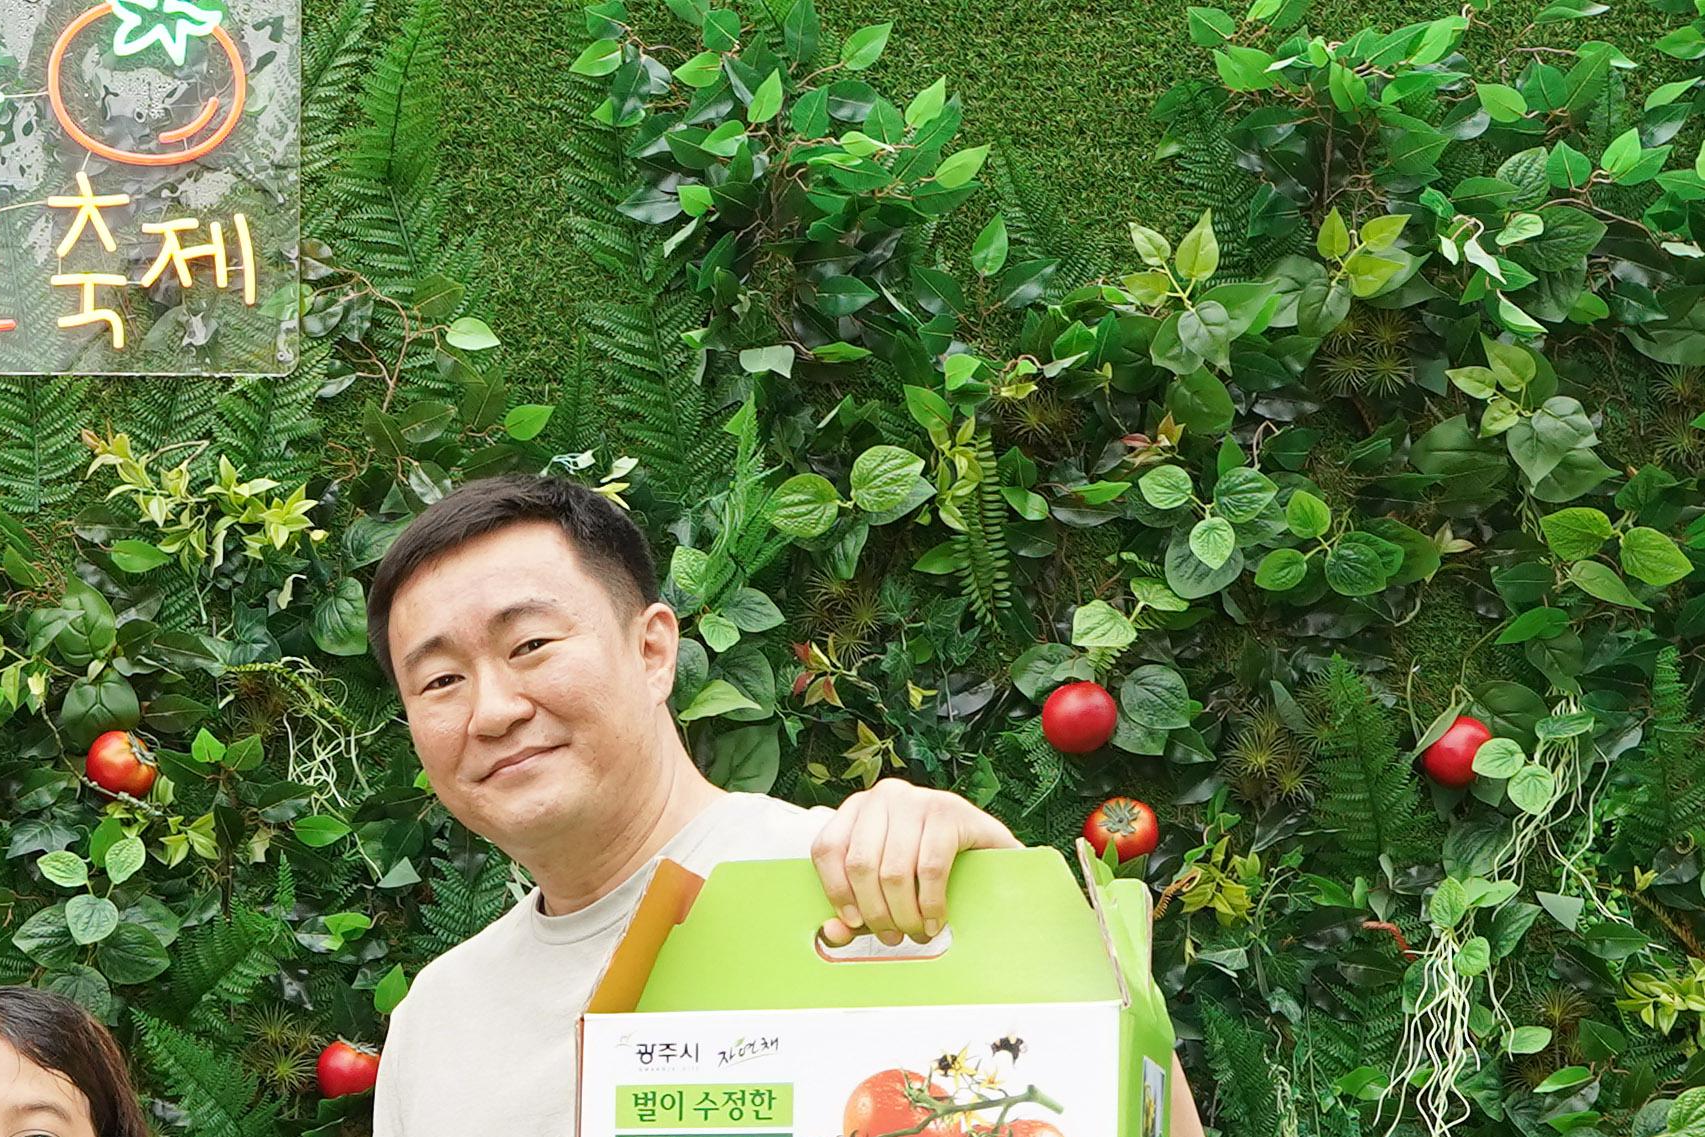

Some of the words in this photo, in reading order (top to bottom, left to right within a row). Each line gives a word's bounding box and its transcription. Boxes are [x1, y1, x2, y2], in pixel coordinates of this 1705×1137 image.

[47, 171, 257, 349] 축제
[636, 1042, 699, 1065] 광주시
[632, 1090, 684, 1123] 벌이
[693, 1088, 777, 1122] 수정한
